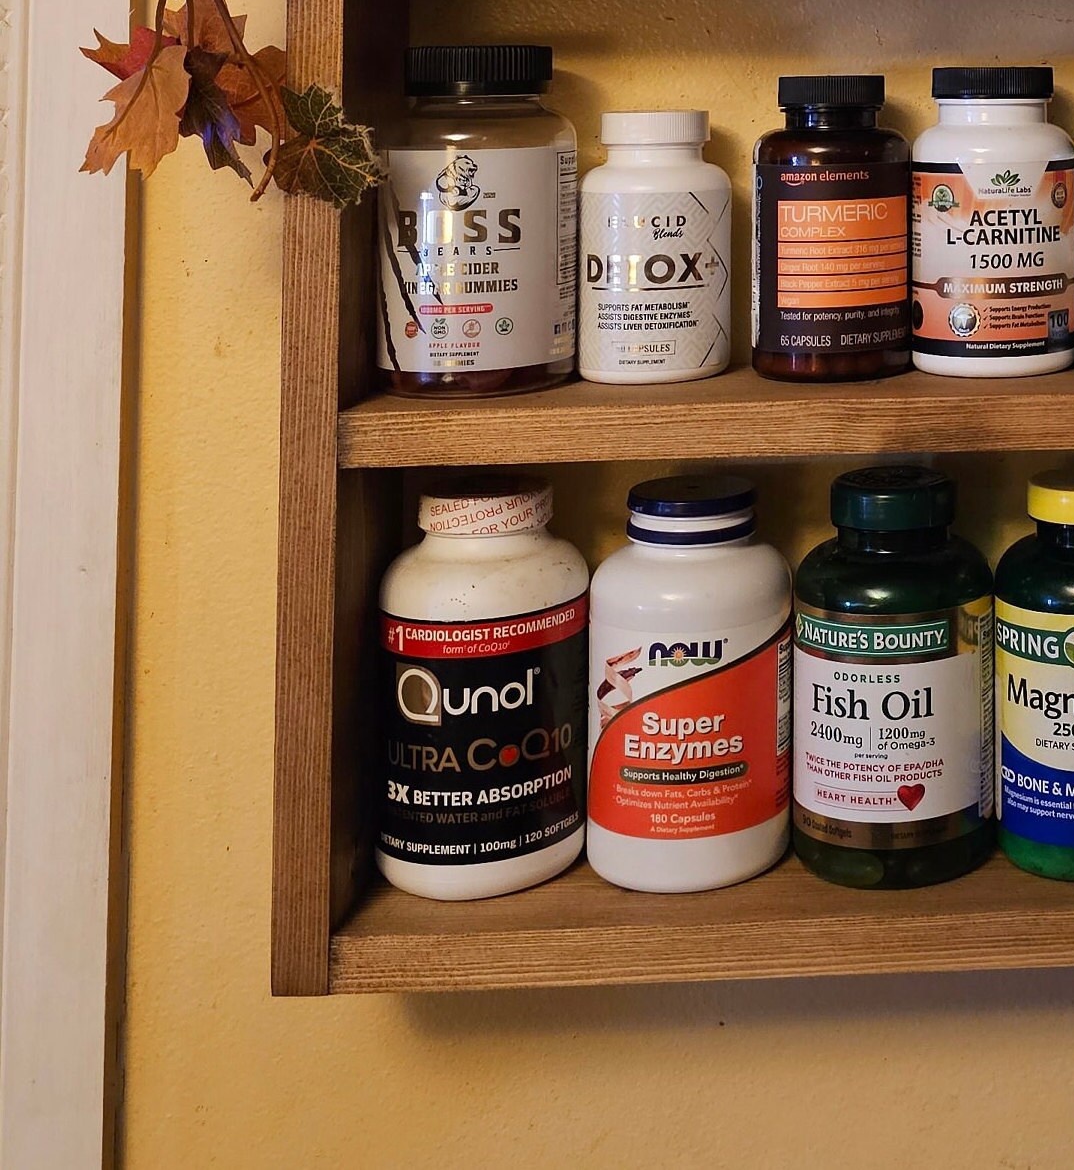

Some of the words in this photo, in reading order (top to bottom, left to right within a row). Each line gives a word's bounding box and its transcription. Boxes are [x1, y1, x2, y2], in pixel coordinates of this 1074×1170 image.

[781, 172, 817, 182] amazon
[820, 170, 869, 181] elements
[781, 203, 888, 223] TURMERIC
[970, 209, 1042, 227] ACETYL
[653, 229, 684, 240] Blends
[781, 226, 846, 238] COMPLEX
[947, 225, 1060, 245] L-CARNITINE
[969, 253, 1012, 269] 1500
[1018, 251, 1044, 268] MG
[943, 282, 1006, 294] MAXIMUM
[1009, 278, 1063, 293] STRENGTH
[780, 311, 801, 320] Tested
[802, 312, 812, 320] for
[814, 311, 843, 322] potency,
[780, 335, 789, 346] 65
[791, 335, 831, 347] CAPSULES
[430, 500, 469, 517] SEALED
[388, 625, 403, 651] #1
[406, 628, 489, 641] CARDIOLOGIST
[493, 609, 575, 638] RECOMMENDED
[805, 621, 869, 650] NATURE'S
[996, 622, 1059, 658] SPRING
[834, 672, 901, 683] ODORLESS
[397, 667, 533, 723] Qunol
[812, 683, 870, 721] Fish
[881, 687, 934, 721] Oil
[642, 712, 724, 741] Super
[810, 721, 863, 748] 2400mg
[879, 728, 925, 739] 1200mg
[624, 732, 743, 764] Enzymes
[878, 742, 887, 750] of
[890, 738, 936, 750] Omega-3
[623, 769, 660, 780] Supports
[662, 770, 697, 781] Healthy
[387, 780, 410, 804] 3X
[413, 788, 473, 806] BETTER
[476, 766, 572, 804] ABSORPTION
[1017, 773, 1049, 794] BONE
[1052, 782, 1062, 796] &
[817, 790, 846, 802] HEART
[524, 831, 543, 845] 120
[544, 813, 579, 838] SOFTGELS
